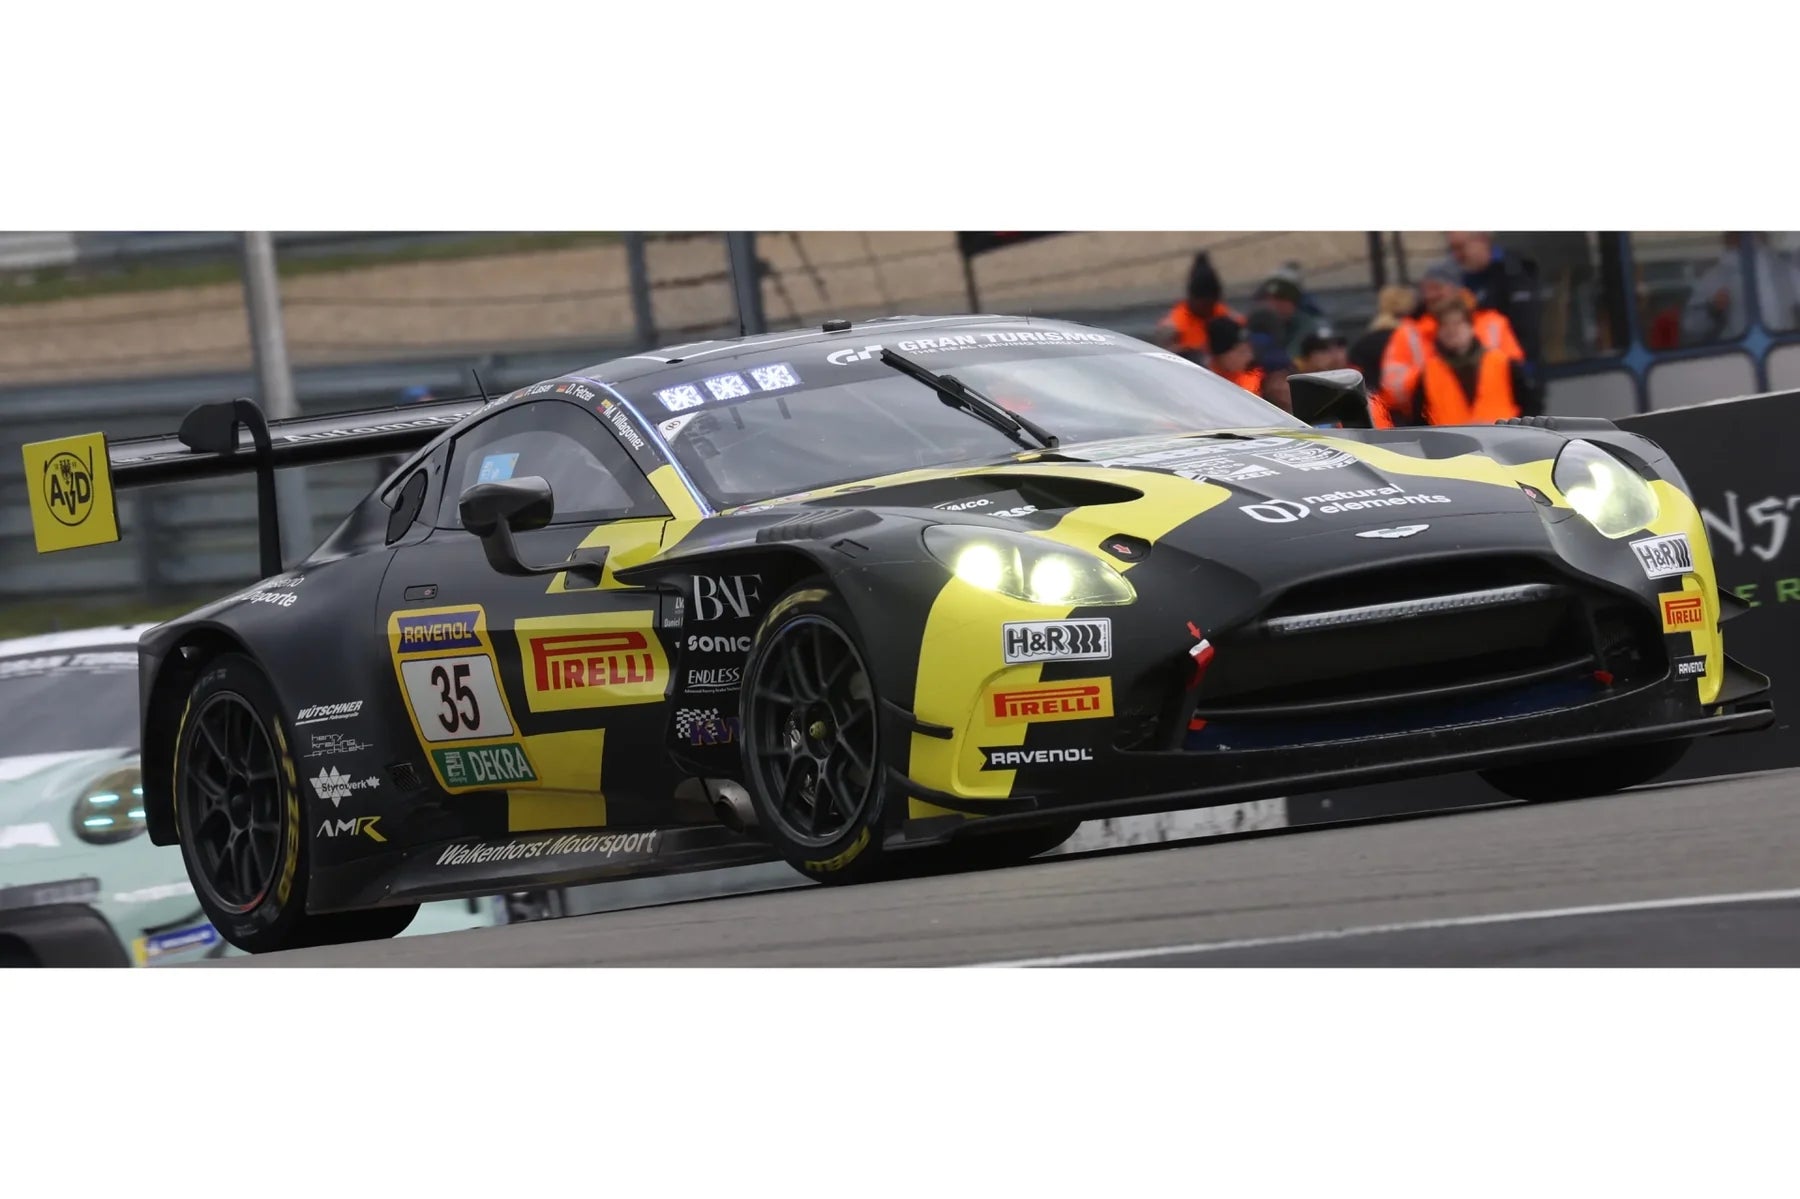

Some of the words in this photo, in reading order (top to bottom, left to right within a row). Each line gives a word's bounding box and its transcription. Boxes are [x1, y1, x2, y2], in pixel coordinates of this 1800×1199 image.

[897, 334, 977, 352] GRAN
[980, 331, 1107, 344] TURISMO
[565, 383, 574, 395] D.
[573, 384, 595, 402] Fetzer
[603, 406, 612, 419] M.
[610, 412, 645, 451] Villagomez
[1302, 483, 1406, 505] natural
[1319, 493, 1452, 514] elements
[1637, 542, 1676, 571] H&R
[1664, 597, 1703, 625] PIRELLI
[403, 621, 473, 645] RAVENOL
[1006, 625, 1069, 658] H&R
[529, 631, 655, 692] PIRELLI
[687, 666, 740, 685] ENDLESS
[297, 700, 364, 720] WÜTSCHNER
[430, 663, 481, 734] 35
[993, 685, 1100, 718] PIRELLI
[467, 747, 534, 783] DEKRA
[990, 748, 1093, 765] RAVENOL
[321, 779, 367, 793] Styrowerk
[316, 815, 388, 843] AMR
[436, 838, 553, 866] Walkenhorst
[549, 829, 658, 859] Motorsport
